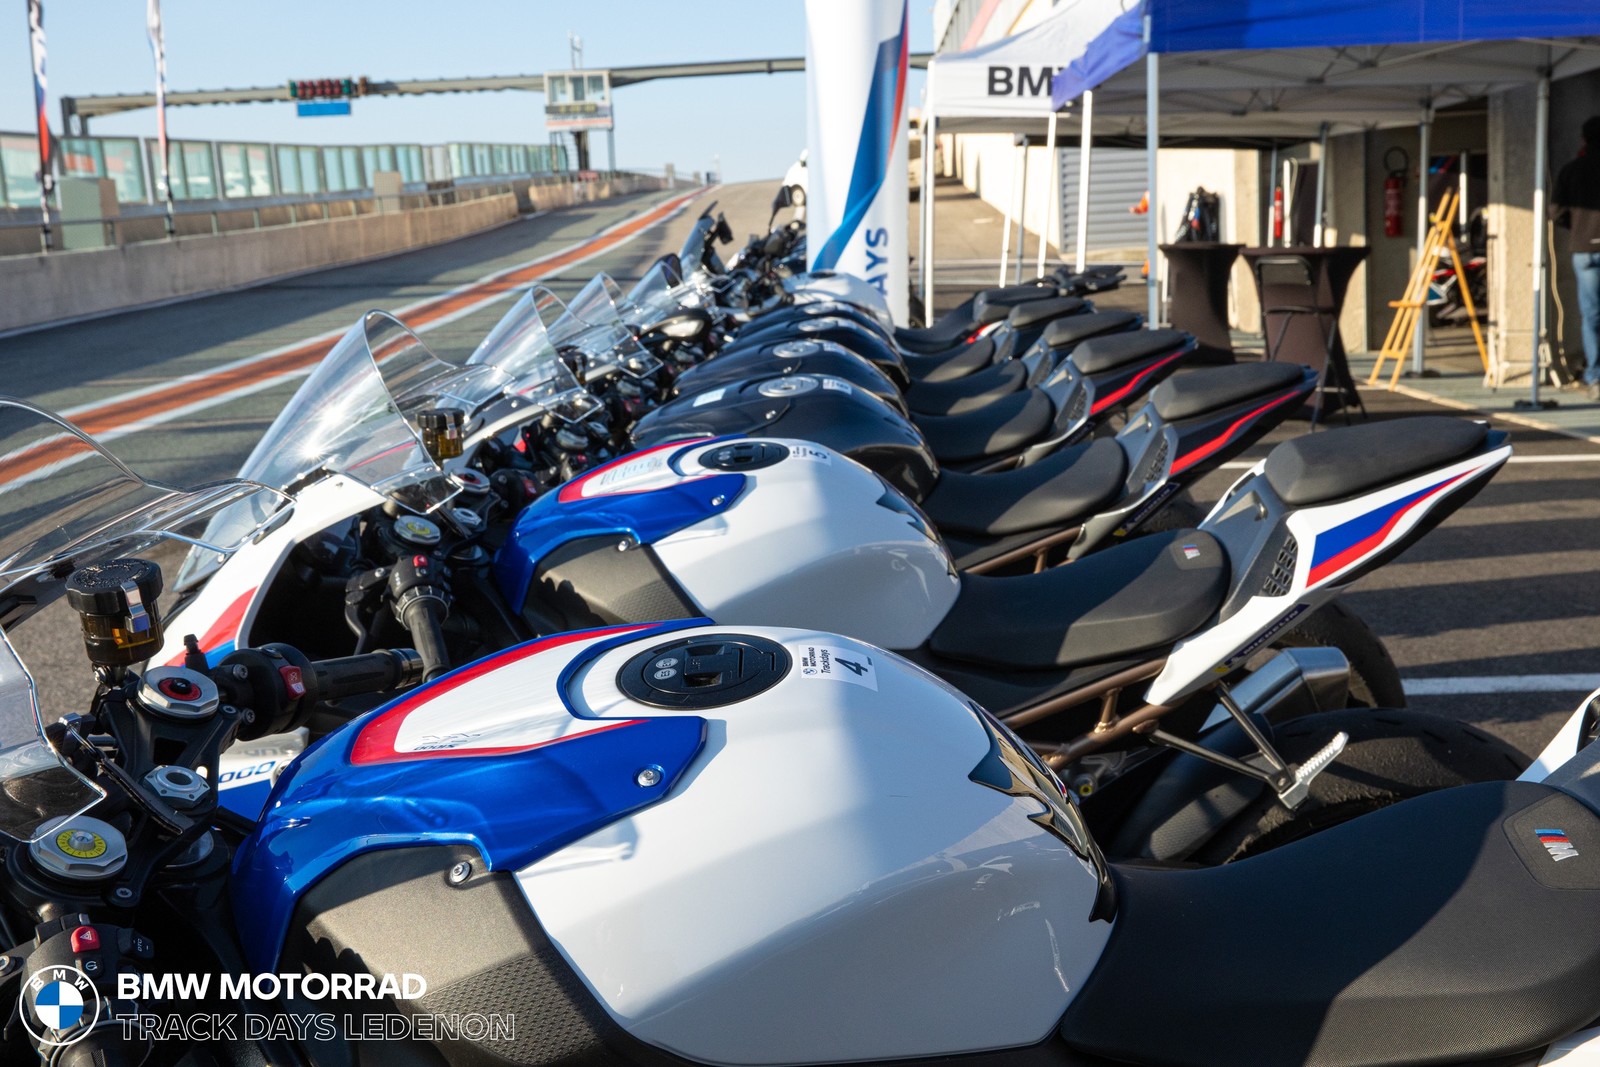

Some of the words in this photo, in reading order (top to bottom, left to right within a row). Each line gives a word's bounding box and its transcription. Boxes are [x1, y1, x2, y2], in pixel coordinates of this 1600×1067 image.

[988, 66, 1065, 96] BM
[866, 227, 888, 296] AYS
[1242, 610, 1299, 656] MICHELIN
[820, 649, 832, 674] Trackdays
[834, 657, 868, 677] 4
[218, 760, 276, 784] 000
